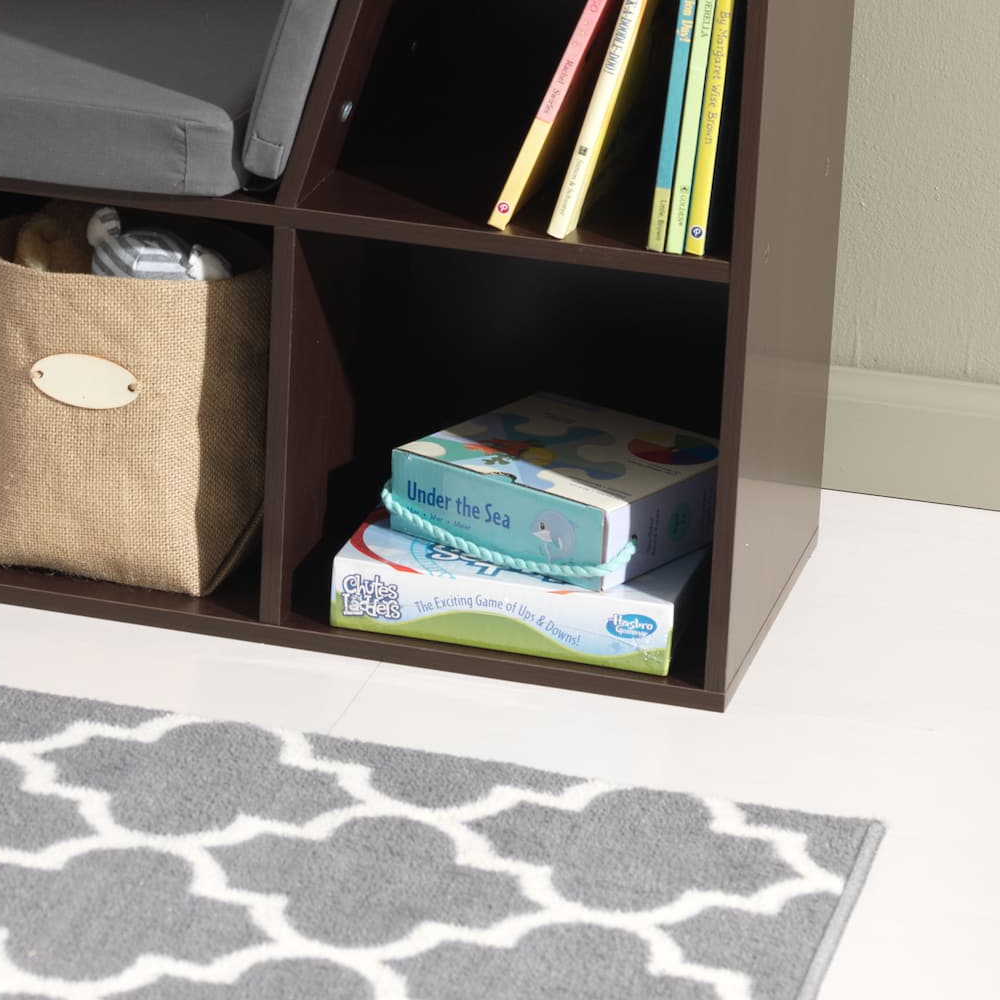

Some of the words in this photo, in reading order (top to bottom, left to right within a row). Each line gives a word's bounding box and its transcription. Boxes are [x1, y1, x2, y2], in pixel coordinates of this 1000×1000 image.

[676, 18, 693, 42] Day!
[718, 9, 730, 25] By
[711, 28, 727, 80] Margaret
[706, 111, 717, 145] Brown
[407, 480, 452, 511] Under
[456, 496, 481, 520] the
[485, 503, 511, 529] Sea
[342, 573, 399, 600] Chutes
[414, 600, 434, 614] The
[434, 594, 473, 610] Exciting
[475, 594, 504, 610] Game
[505, 601, 517, 613] of
[518, 604, 536, 622] Ups
[536, 615, 546, 627] &
[545, 620, 582, 647] Downs!
[609, 614, 654, 631] Hasbro
